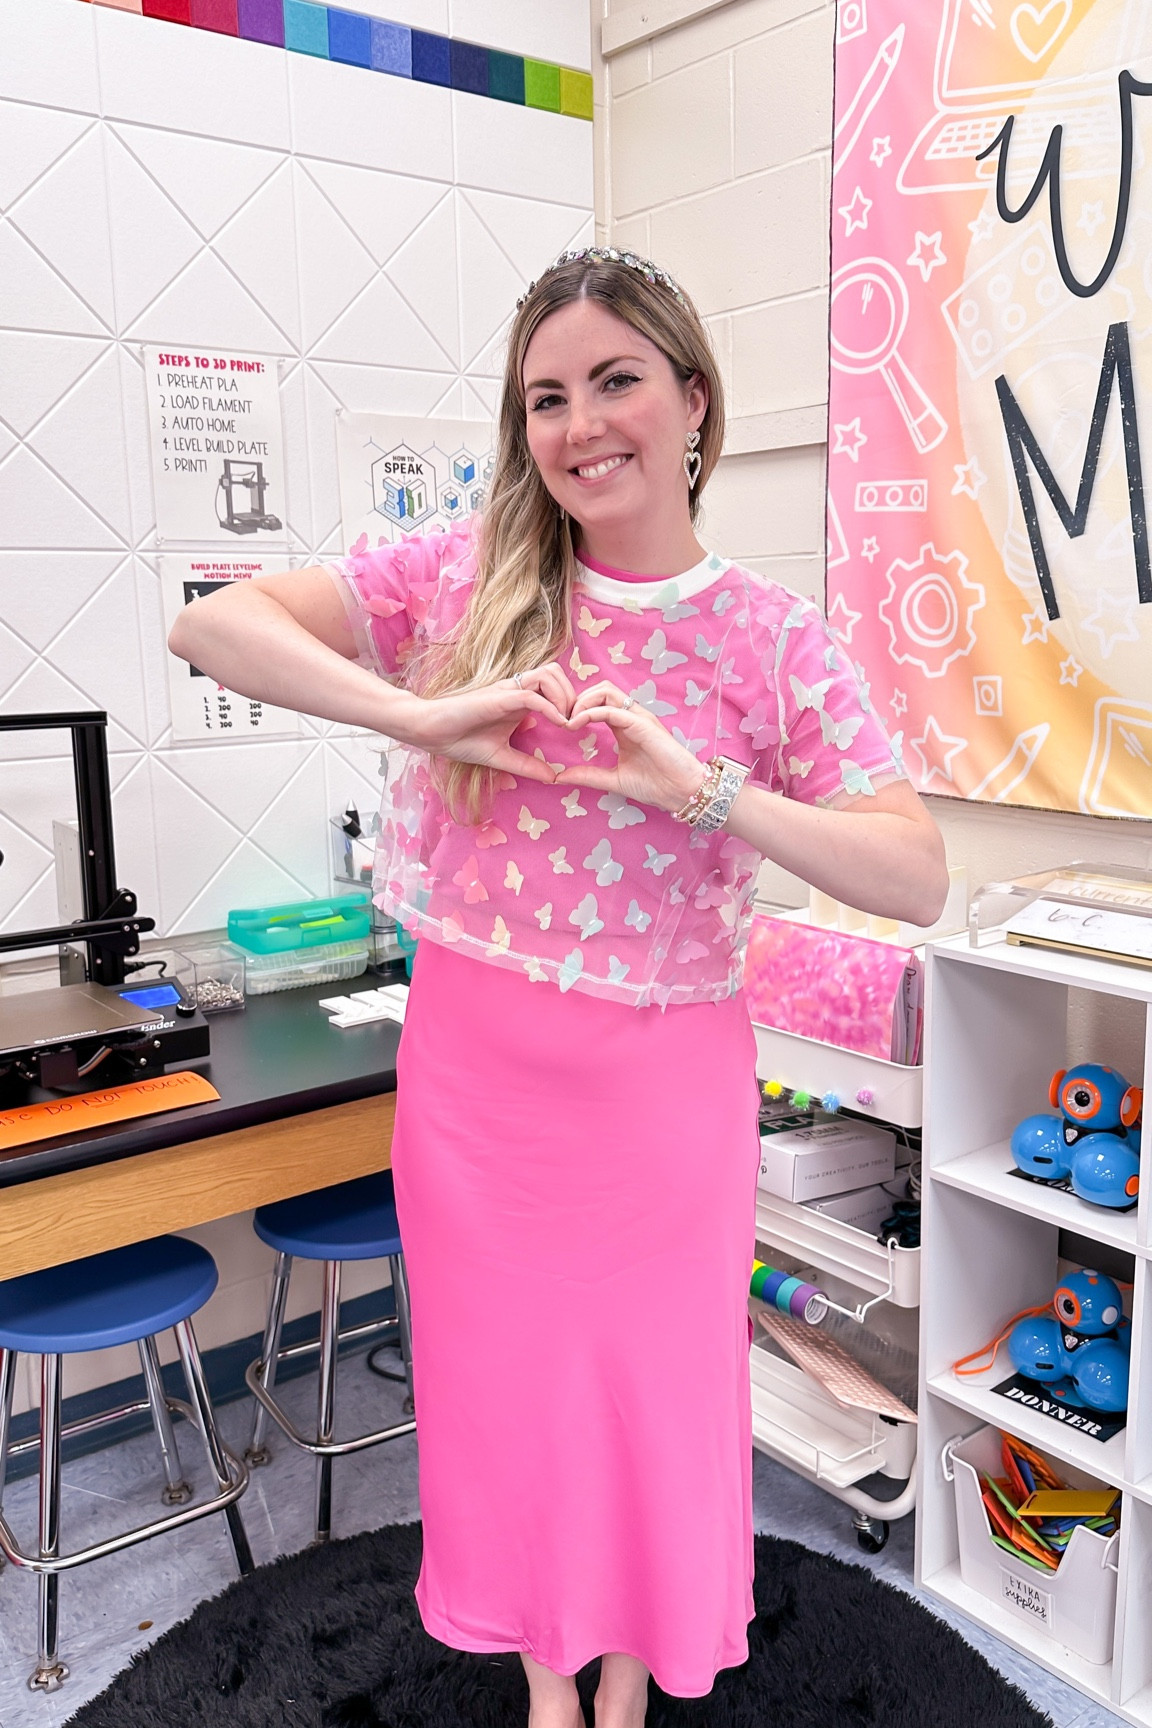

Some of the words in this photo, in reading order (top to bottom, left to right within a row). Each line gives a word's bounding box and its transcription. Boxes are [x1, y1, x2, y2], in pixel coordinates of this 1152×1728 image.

[158, 353, 191, 368] STEPS
[194, 356, 210, 369] TO
[213, 358, 227, 370] 3D
[230, 359, 265, 374] PRINT:
[167, 373, 214, 390] PREHEAT
[217, 377, 239, 392] PLA
[170, 394, 200, 410] LOAD
[202, 396, 253, 414] FILAMENT
[172, 415, 204, 431] AUTO
[206, 417, 237, 434] HOME
[174, 437, 203, 452] LEVEL
[205, 438, 235, 454] BUILD
[237, 440, 269, 456] PLATE
[384, 462, 424, 476] SPEAK
[383, 476, 428, 520] 3D
[191, 563, 210, 571] BUILD
[212, 563, 231, 571] PLATE
[233, 563, 263, 571] LEVELING
[204, 572, 231, 580] MOTION
[233, 572, 252, 580] MENU
[141, 1020, 176, 1032] Ender
[44, 1103, 73, 1115] DO
[763, 1116, 819, 1130] PLA
[1004, 1386, 1102, 1436] DONNER
[1005, 1586, 1047, 1619] supplies
